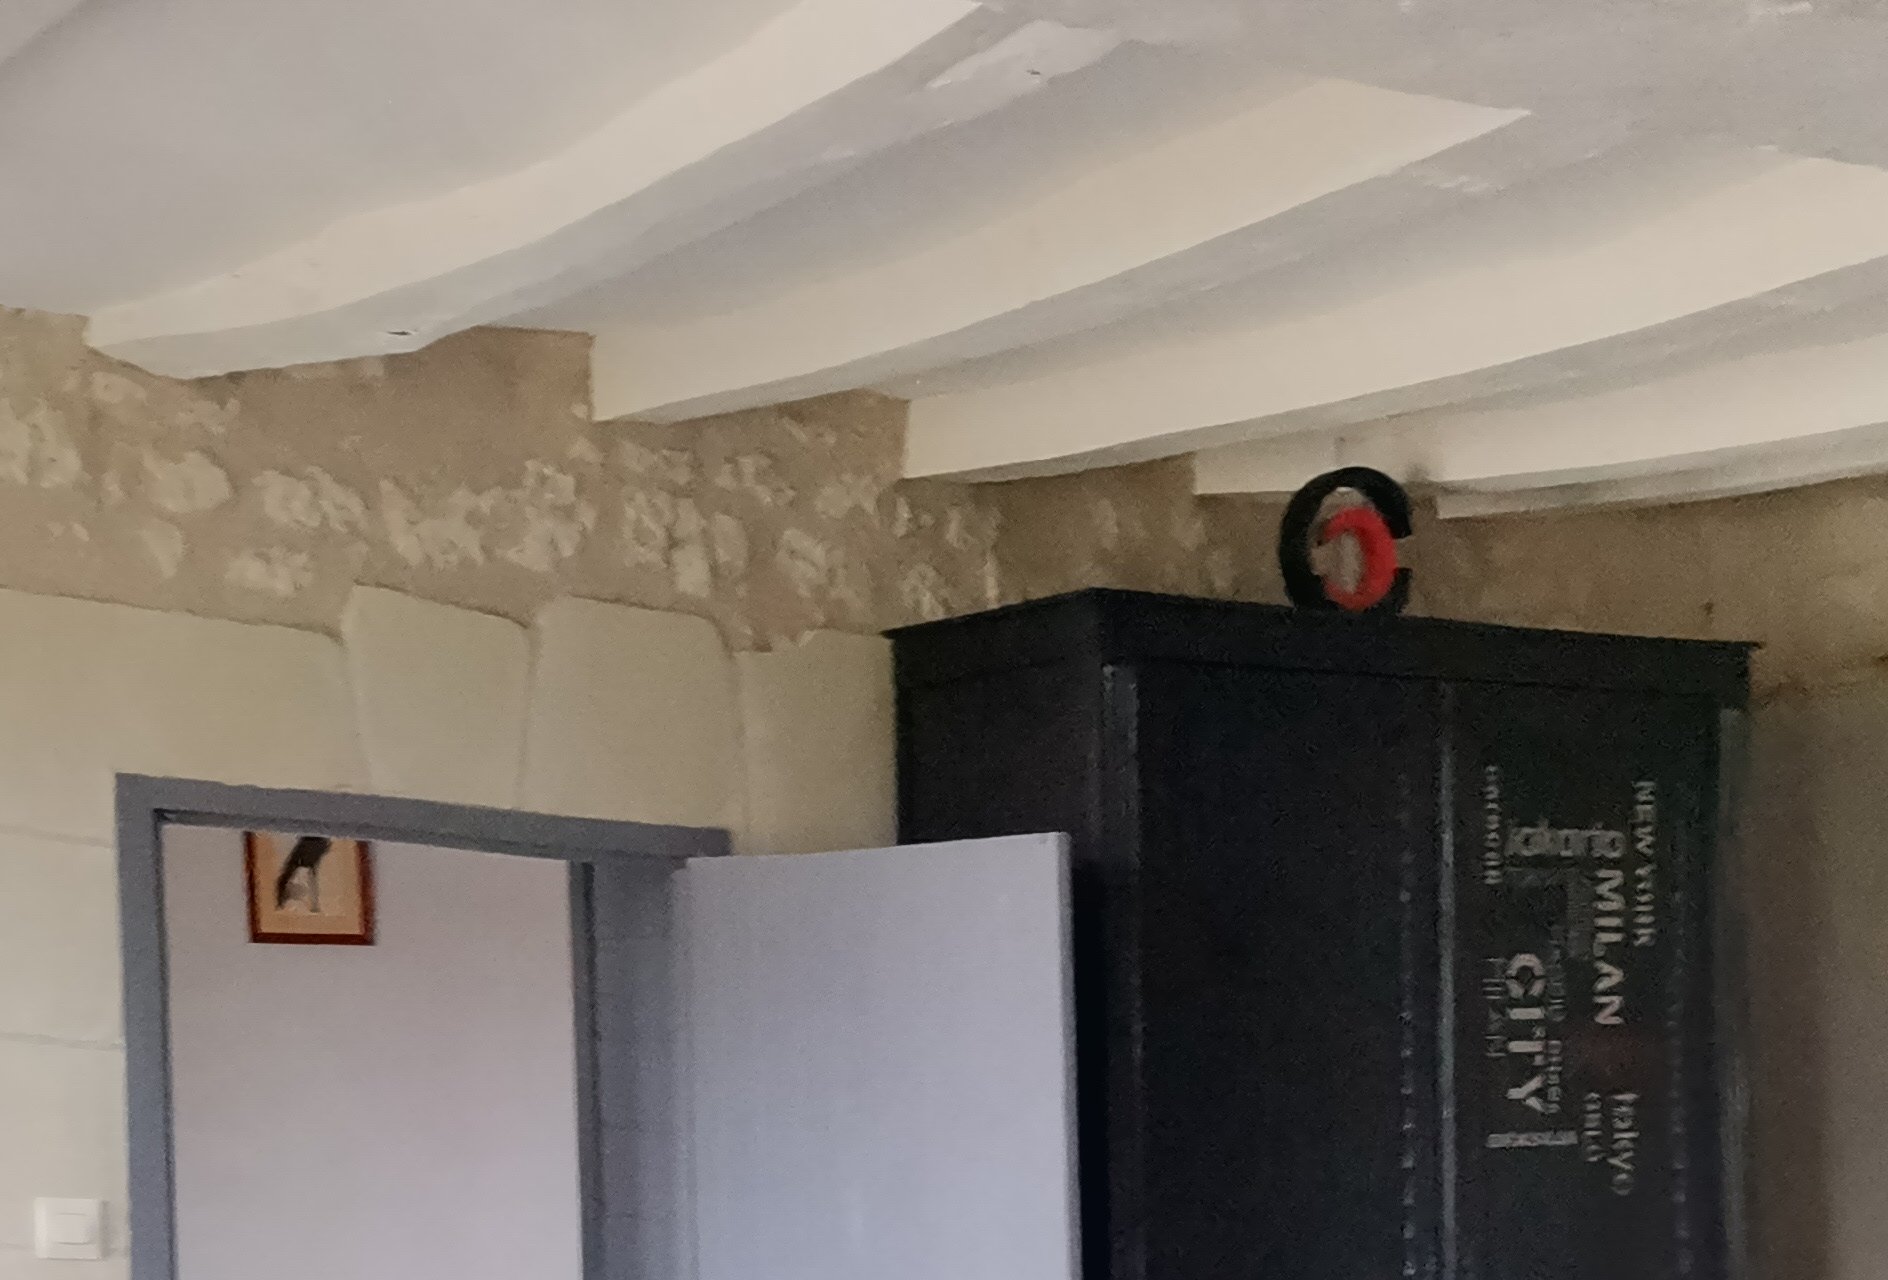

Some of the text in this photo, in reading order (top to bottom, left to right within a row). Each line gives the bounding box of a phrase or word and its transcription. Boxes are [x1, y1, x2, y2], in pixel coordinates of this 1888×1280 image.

[1632, 780, 1658, 857] NEW
[1592, 868, 1626, 1025] MILAN
[1506, 952, 1546, 1114] CITY
[1606, 1091, 1641, 1197] tokyo
